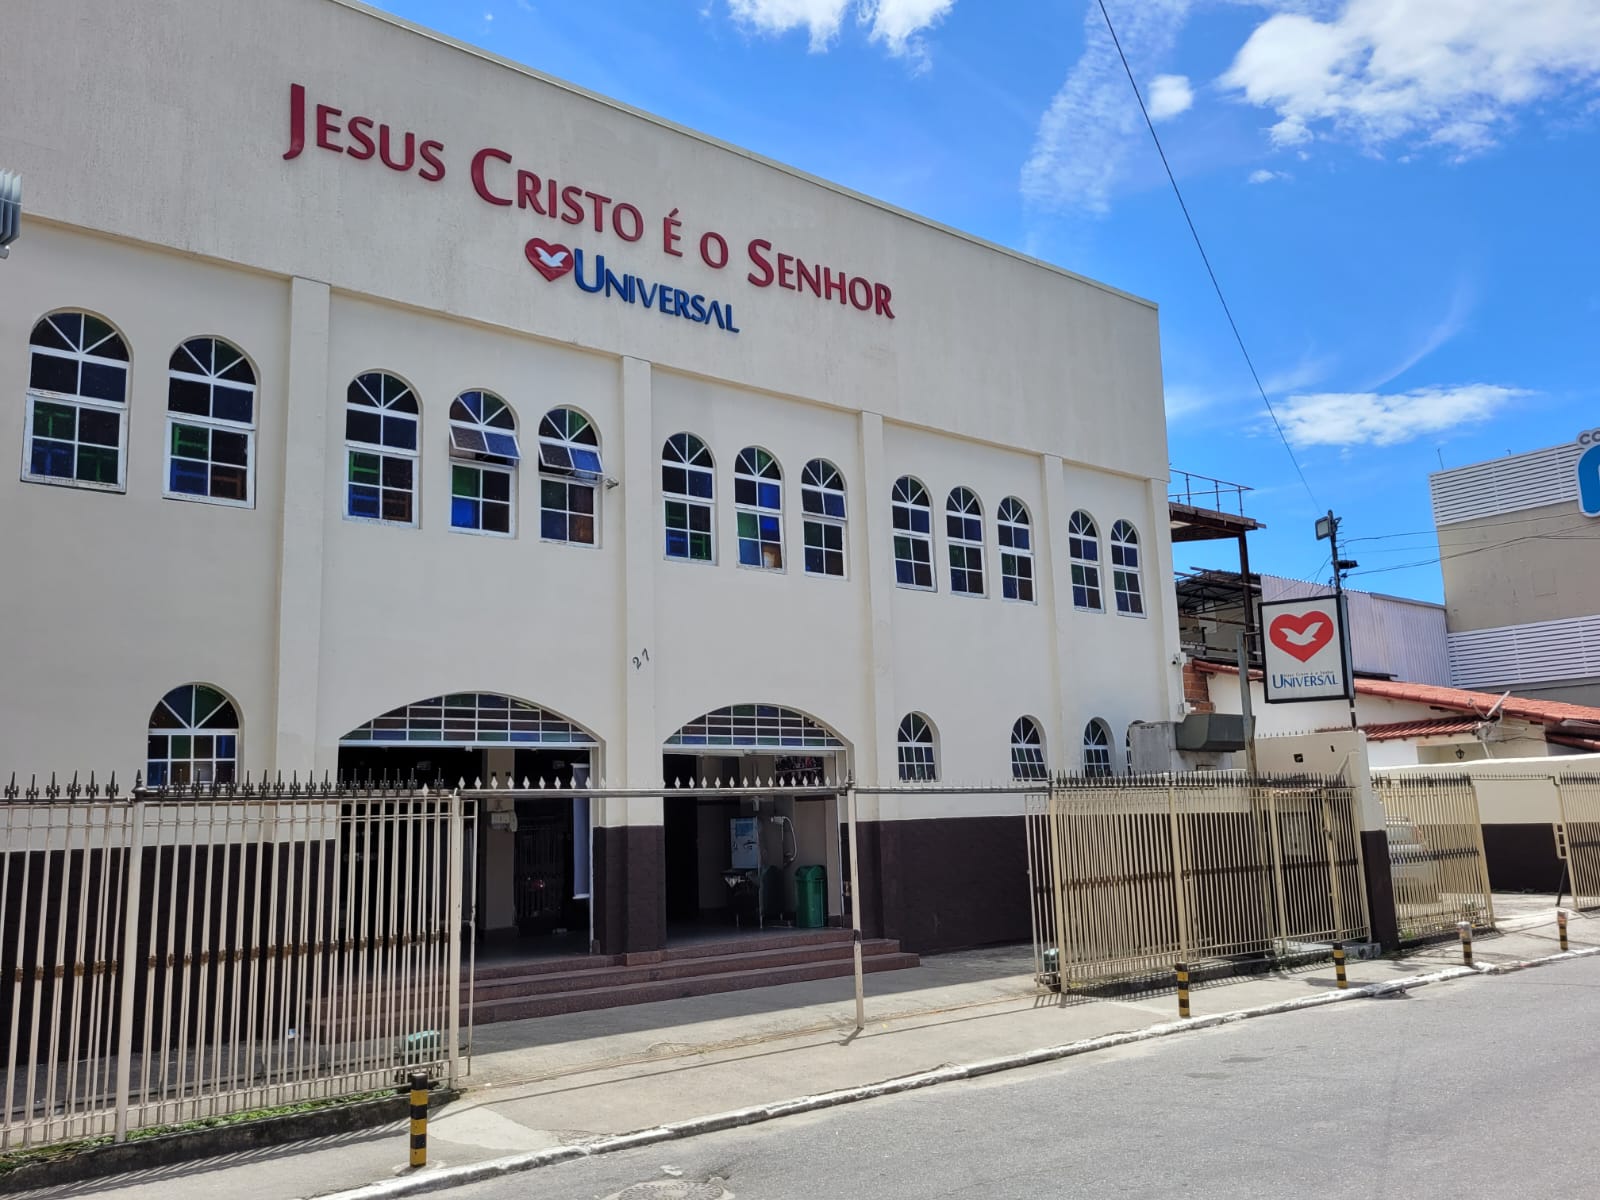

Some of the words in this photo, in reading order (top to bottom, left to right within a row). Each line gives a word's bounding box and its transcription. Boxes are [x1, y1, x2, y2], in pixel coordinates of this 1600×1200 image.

[283, 83, 446, 182] JESUS
[470, 147, 644, 242] CRISTO
[663, 208, 683, 257] É
[700, 231, 729, 269] O
[747, 238, 895, 319] SENHOR
[573, 247, 740, 333] UNIVERSAL
[1272, 673, 1339, 689] UNIVERSAL
